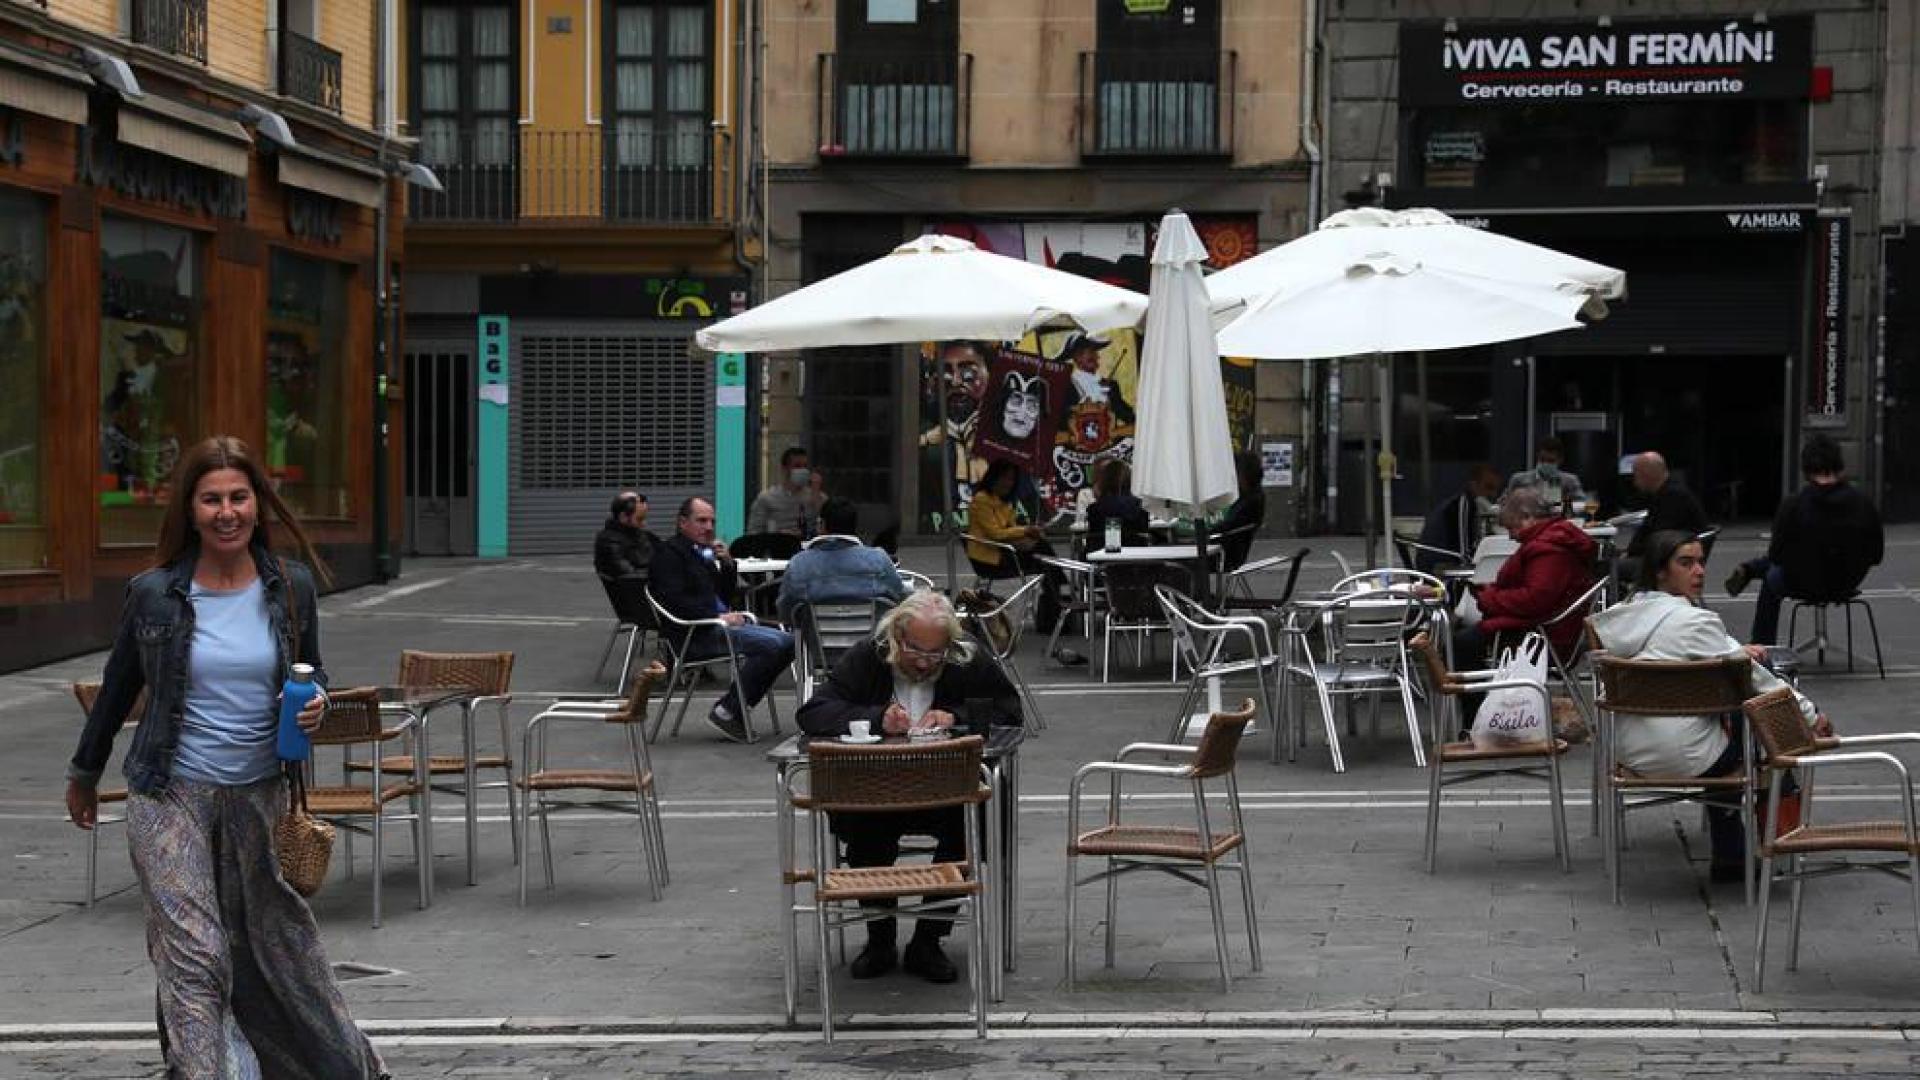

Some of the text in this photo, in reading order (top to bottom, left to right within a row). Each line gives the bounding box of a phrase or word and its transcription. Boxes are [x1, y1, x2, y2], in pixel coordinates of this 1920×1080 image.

[1444, 24, 1774, 70] ¡VIVA SAN FERMÍN!
[1461, 80, 1584, 99] Cervecería
[1605, 77, 1744, 96] Restaurante
[1741, 213, 1802, 229] AMBAR
[1826, 222, 1841, 317] Restaurante
[486, 321, 501, 384] BaG
